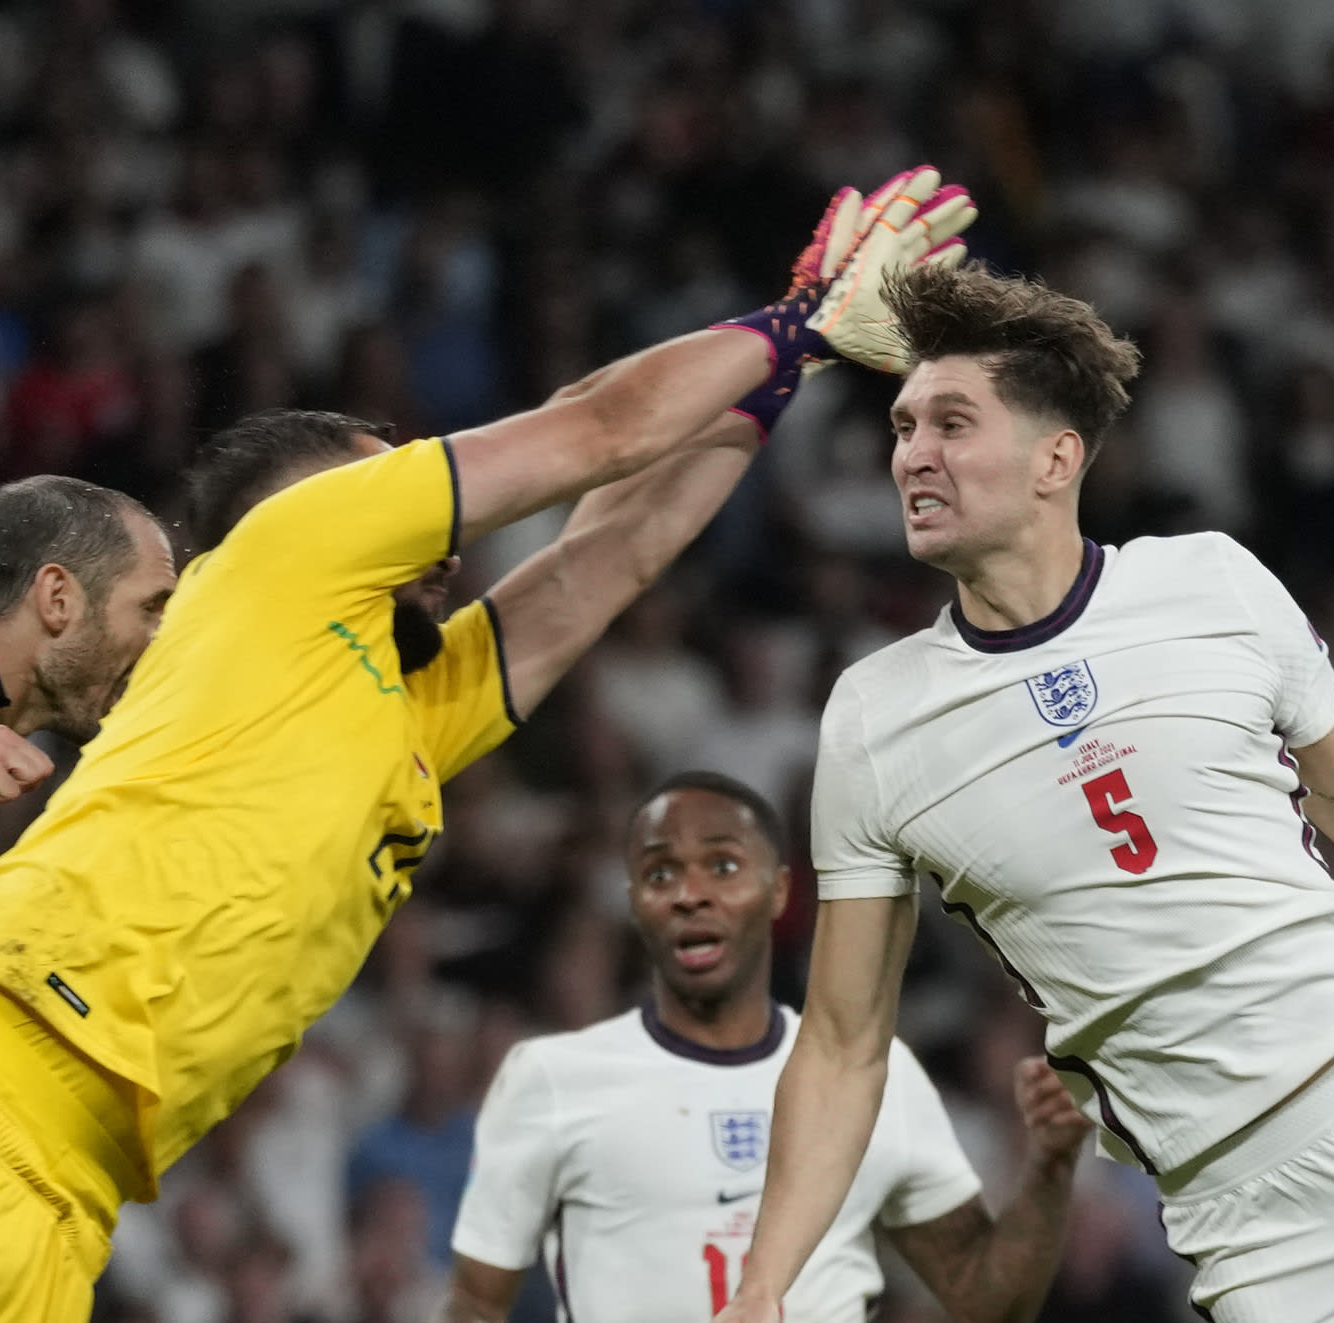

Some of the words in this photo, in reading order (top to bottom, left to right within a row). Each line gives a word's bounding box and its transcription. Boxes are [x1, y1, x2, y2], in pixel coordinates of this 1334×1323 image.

[1079, 739, 1099, 754] ITALY
[1115, 745, 1138, 758] FINAL
[1081, 768, 1158, 875] 5
